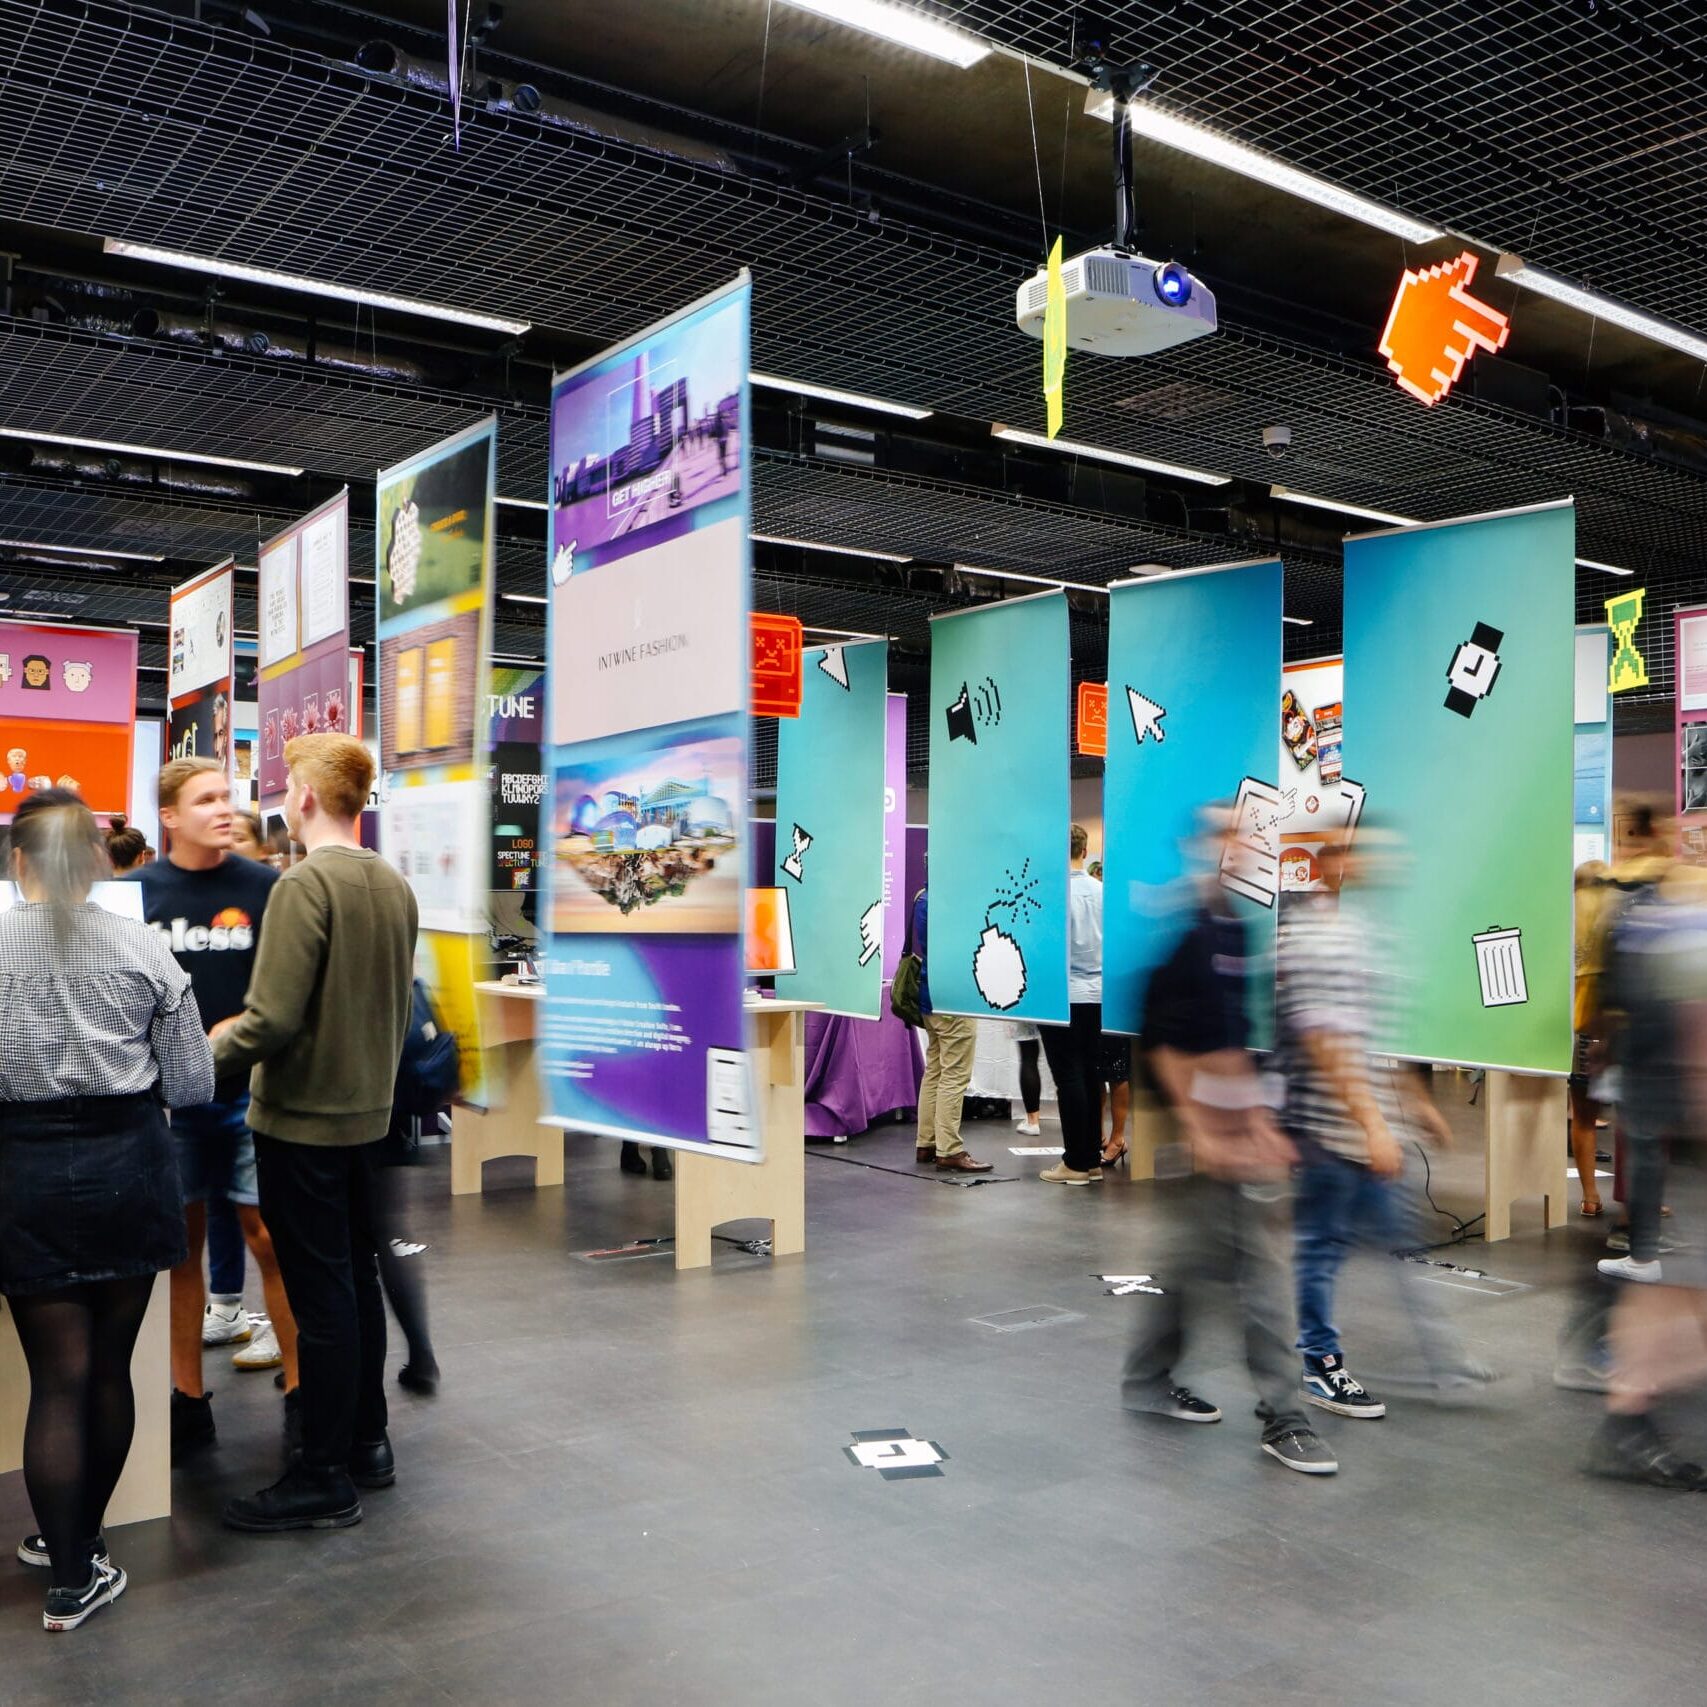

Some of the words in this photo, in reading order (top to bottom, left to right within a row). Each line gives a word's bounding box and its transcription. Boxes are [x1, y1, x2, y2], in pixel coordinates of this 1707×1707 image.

[612, 486, 632, 507] GET
[598, 646, 637, 672] INTWINE
[639, 633, 688, 660] FASHION
[511, 838, 534, 849] LOGO
[497, 850, 530, 859] SPECTUNE
